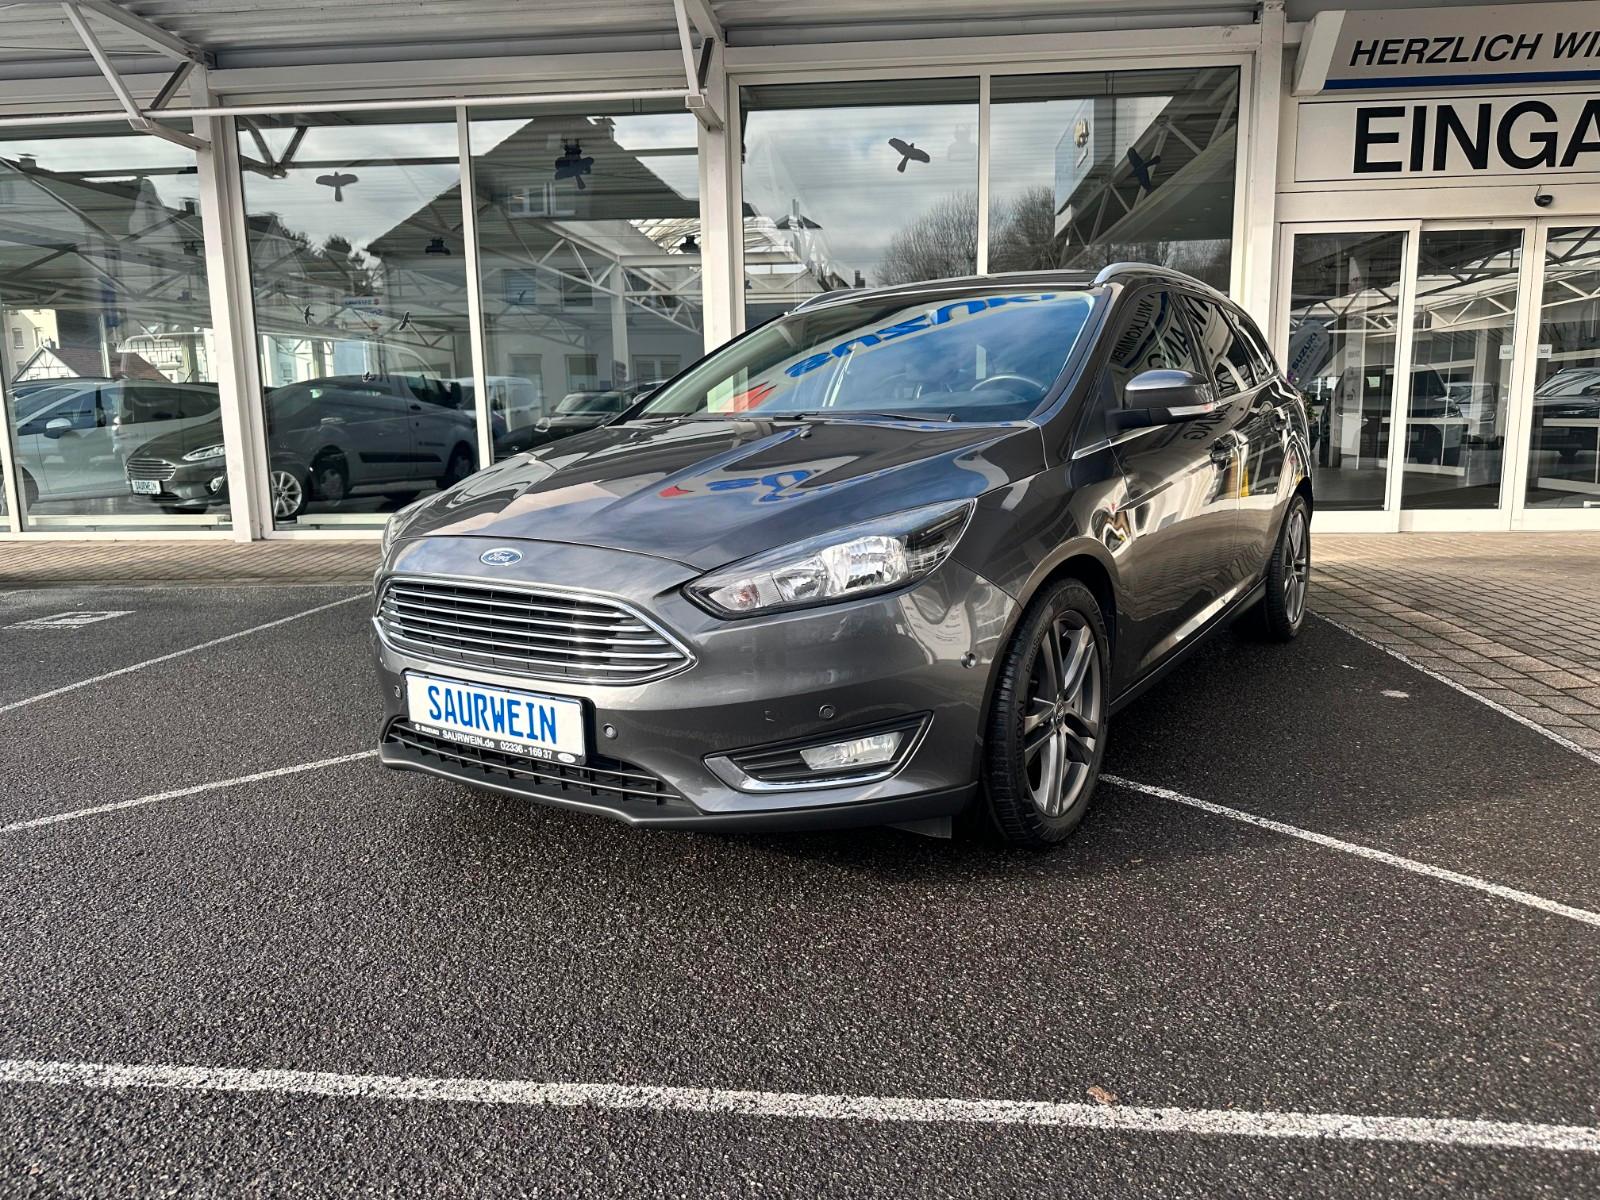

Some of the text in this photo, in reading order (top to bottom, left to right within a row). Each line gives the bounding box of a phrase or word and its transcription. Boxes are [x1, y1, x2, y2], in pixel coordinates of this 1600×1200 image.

[1349, 33, 1543, 66] HERZLICH
[1353, 99, 1600, 174] EINGA
[428, 685, 557, 744] SAURWEIN
[442, 730, 494, 748] SAURWEIN.de
[500, 741, 523, 753] 02336
